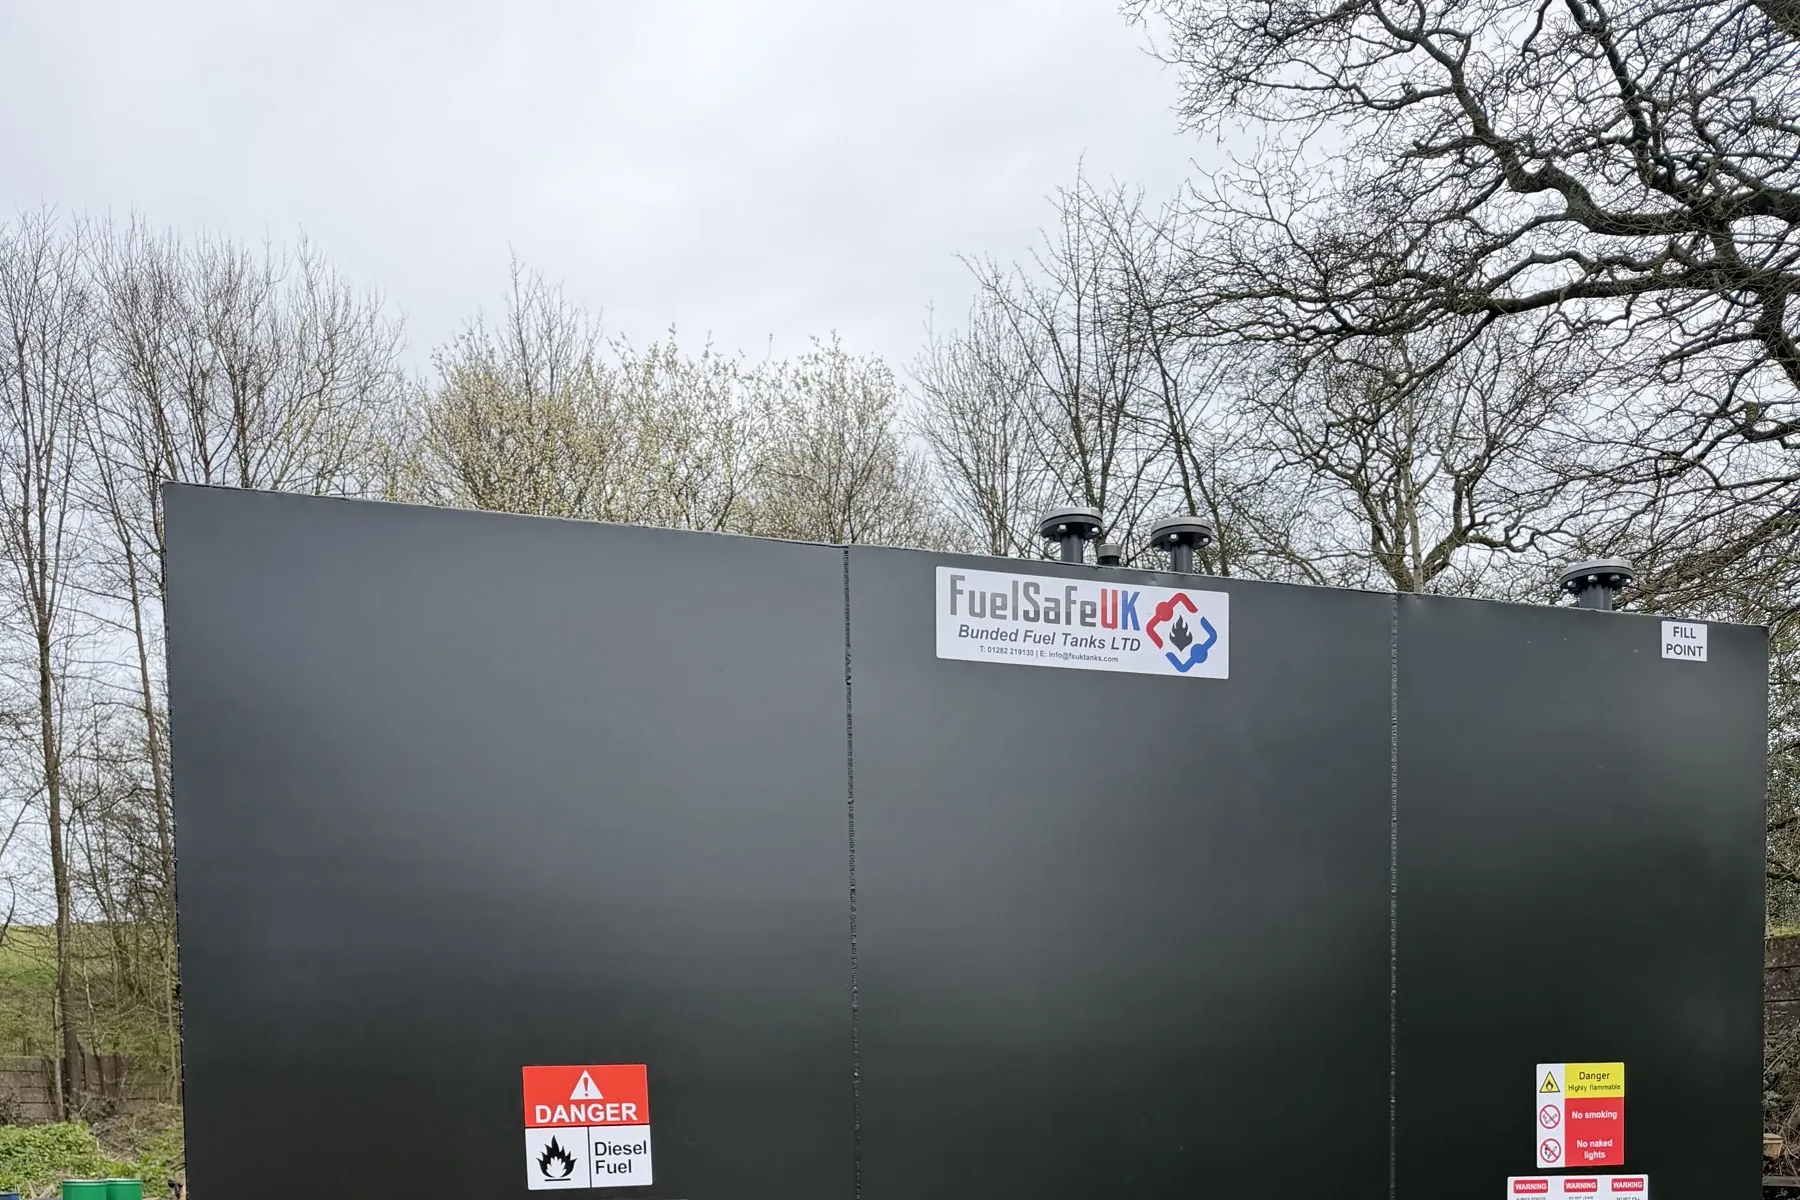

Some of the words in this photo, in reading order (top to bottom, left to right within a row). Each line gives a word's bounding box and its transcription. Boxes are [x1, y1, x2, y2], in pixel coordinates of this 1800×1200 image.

[949, 574, 1141, 632] FuelSafeUK
[958, 624, 1018, 643] Bunded
[1023, 629, 1056, 646] Fuel
[1062, 633, 1106, 650] Tanks
[1111, 637, 1141, 652] LTD
[1673, 626, 1696, 639] FILL
[979, 645, 986, 653] T:
[987, 646, 1008, 655] 01282
[1010, 647, 1034, 657] 219130
[1666, 643, 1704, 657] POINT
[1579, 1071, 1610, 1082] Danger
[1568, 1084, 1587, 1092] Highly
[1590, 1083, 1621, 1091] flammable
[535, 1102, 639, 1124] DANGER
[1571, 1110, 1583, 1119] No
[1585, 1109, 1618, 1120] smoking
[594, 1140, 647, 1157] Diesel
[1576, 1140, 1588, 1148] No
[1590, 1139, 1613, 1147] naked
[1584, 1151, 1606, 1161] lights
[595, 1159, 632, 1175] Fuel
[1613, 1181, 1643, 1189] WARNING
